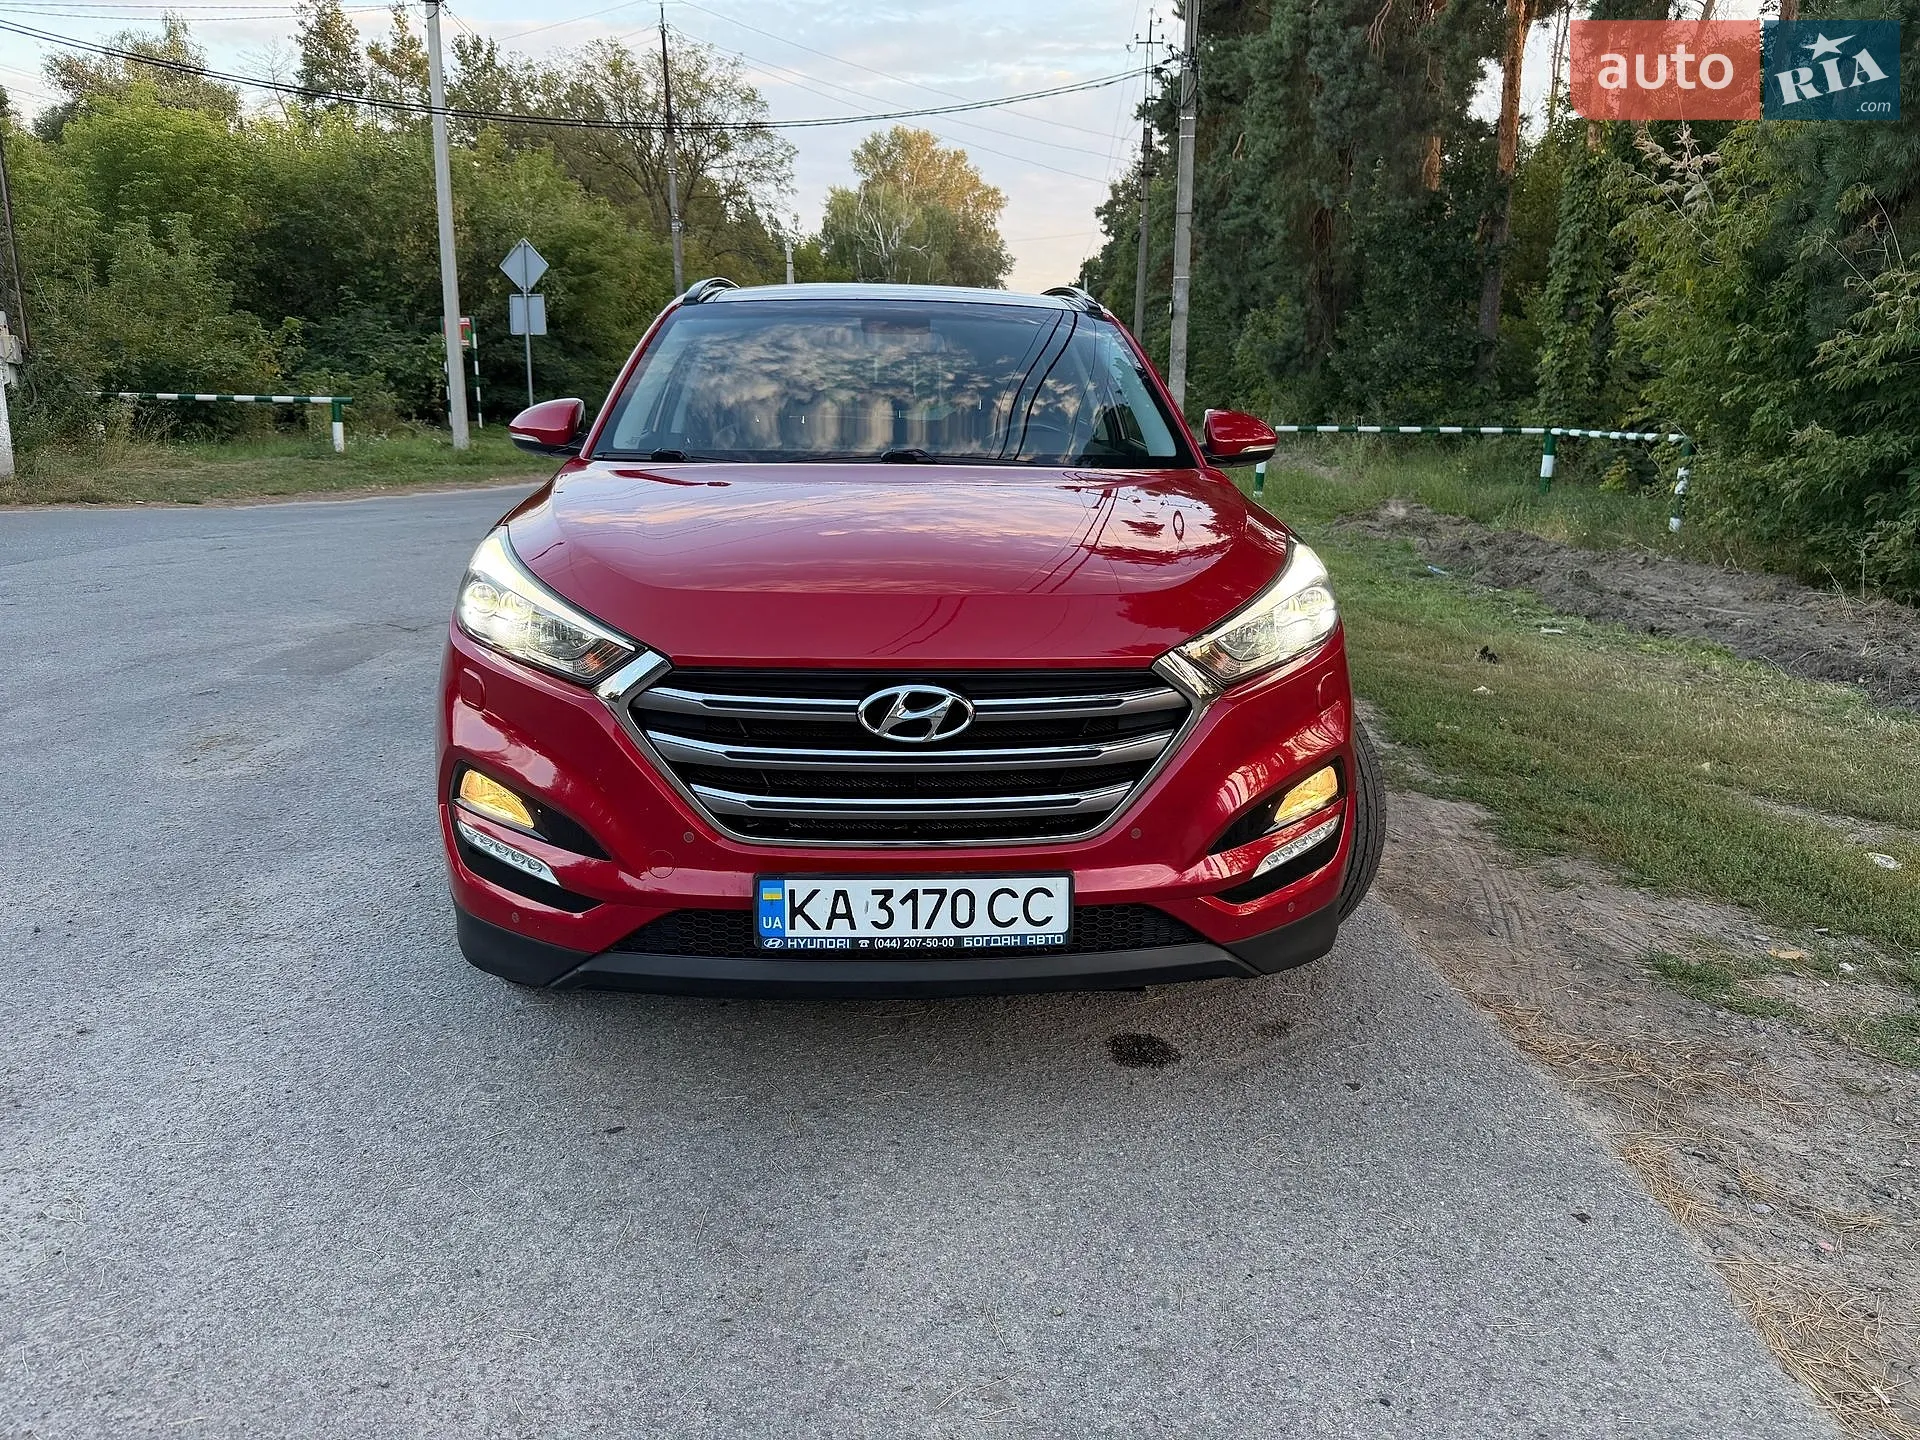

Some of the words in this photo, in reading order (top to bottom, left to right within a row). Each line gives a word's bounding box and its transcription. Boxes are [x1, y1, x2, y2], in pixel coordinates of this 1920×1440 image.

[788, 888, 857, 931] KA
[870, 888, 976, 930] 3170
[987, 887, 1055, 928] CC
[762, 916, 783, 929] UA
[787, 938, 850, 949] HYUNDAI
[874, 938, 901, 949] (044)
[903, 937, 955, 948] 207-50-00
[963, 936, 1021, 947] БОГДАН
[1026, 934, 1064, 945] АВТО
